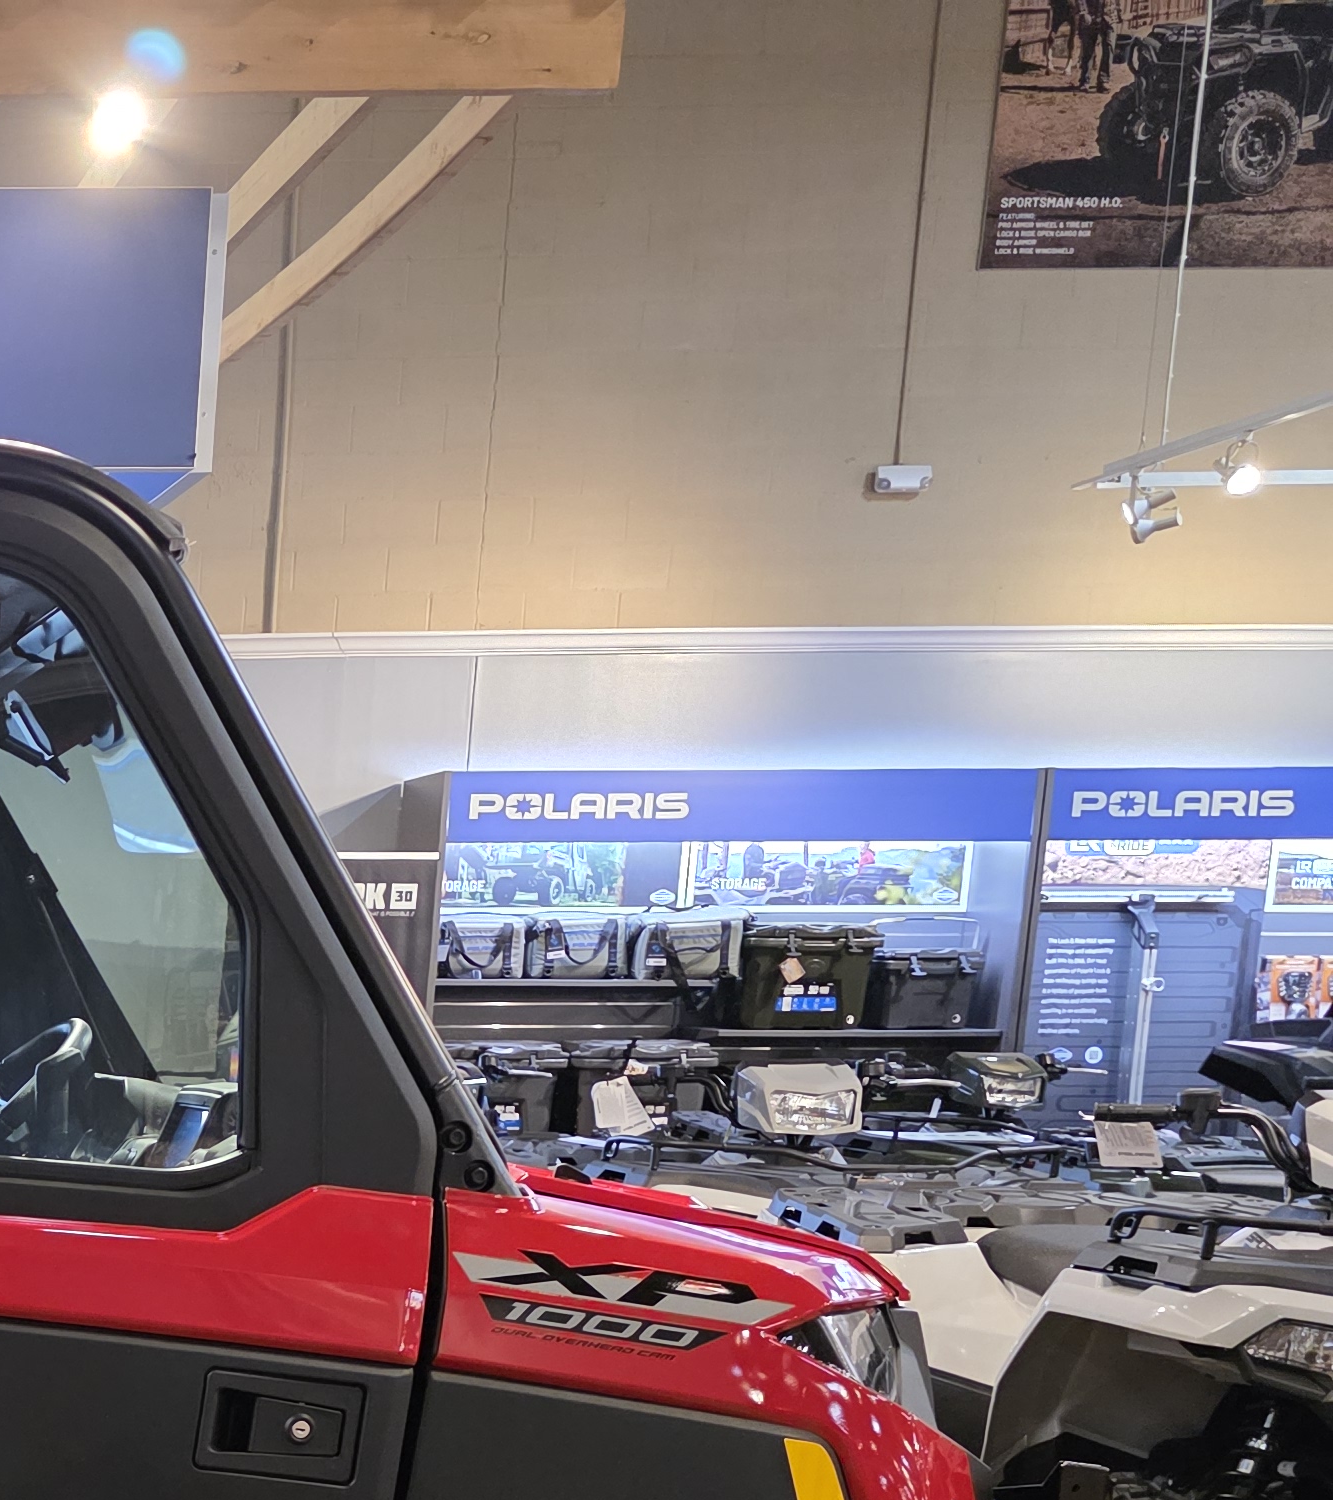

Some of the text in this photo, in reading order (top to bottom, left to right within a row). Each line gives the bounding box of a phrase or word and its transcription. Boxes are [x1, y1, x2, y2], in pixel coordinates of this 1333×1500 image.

[1000, 196, 1123, 208] SPORTSMAN 450 H.O.
[1036, 221, 1058, 229] WHEEL
[468, 792, 690, 820] POLARIS
[1071, 790, 1295, 818] POLARIS
[441, 879, 486, 893] TORAGE
[711, 878, 767, 891] STORAGE
[1292, 877, 1333, 889] COMPA
[395, 891, 412, 902] 30
[478, 1249, 760, 1306] XP
[504, 1301, 699, 1348] 1000
[491, 1326, 676, 1362] DUAL OVERHEAD CAM
